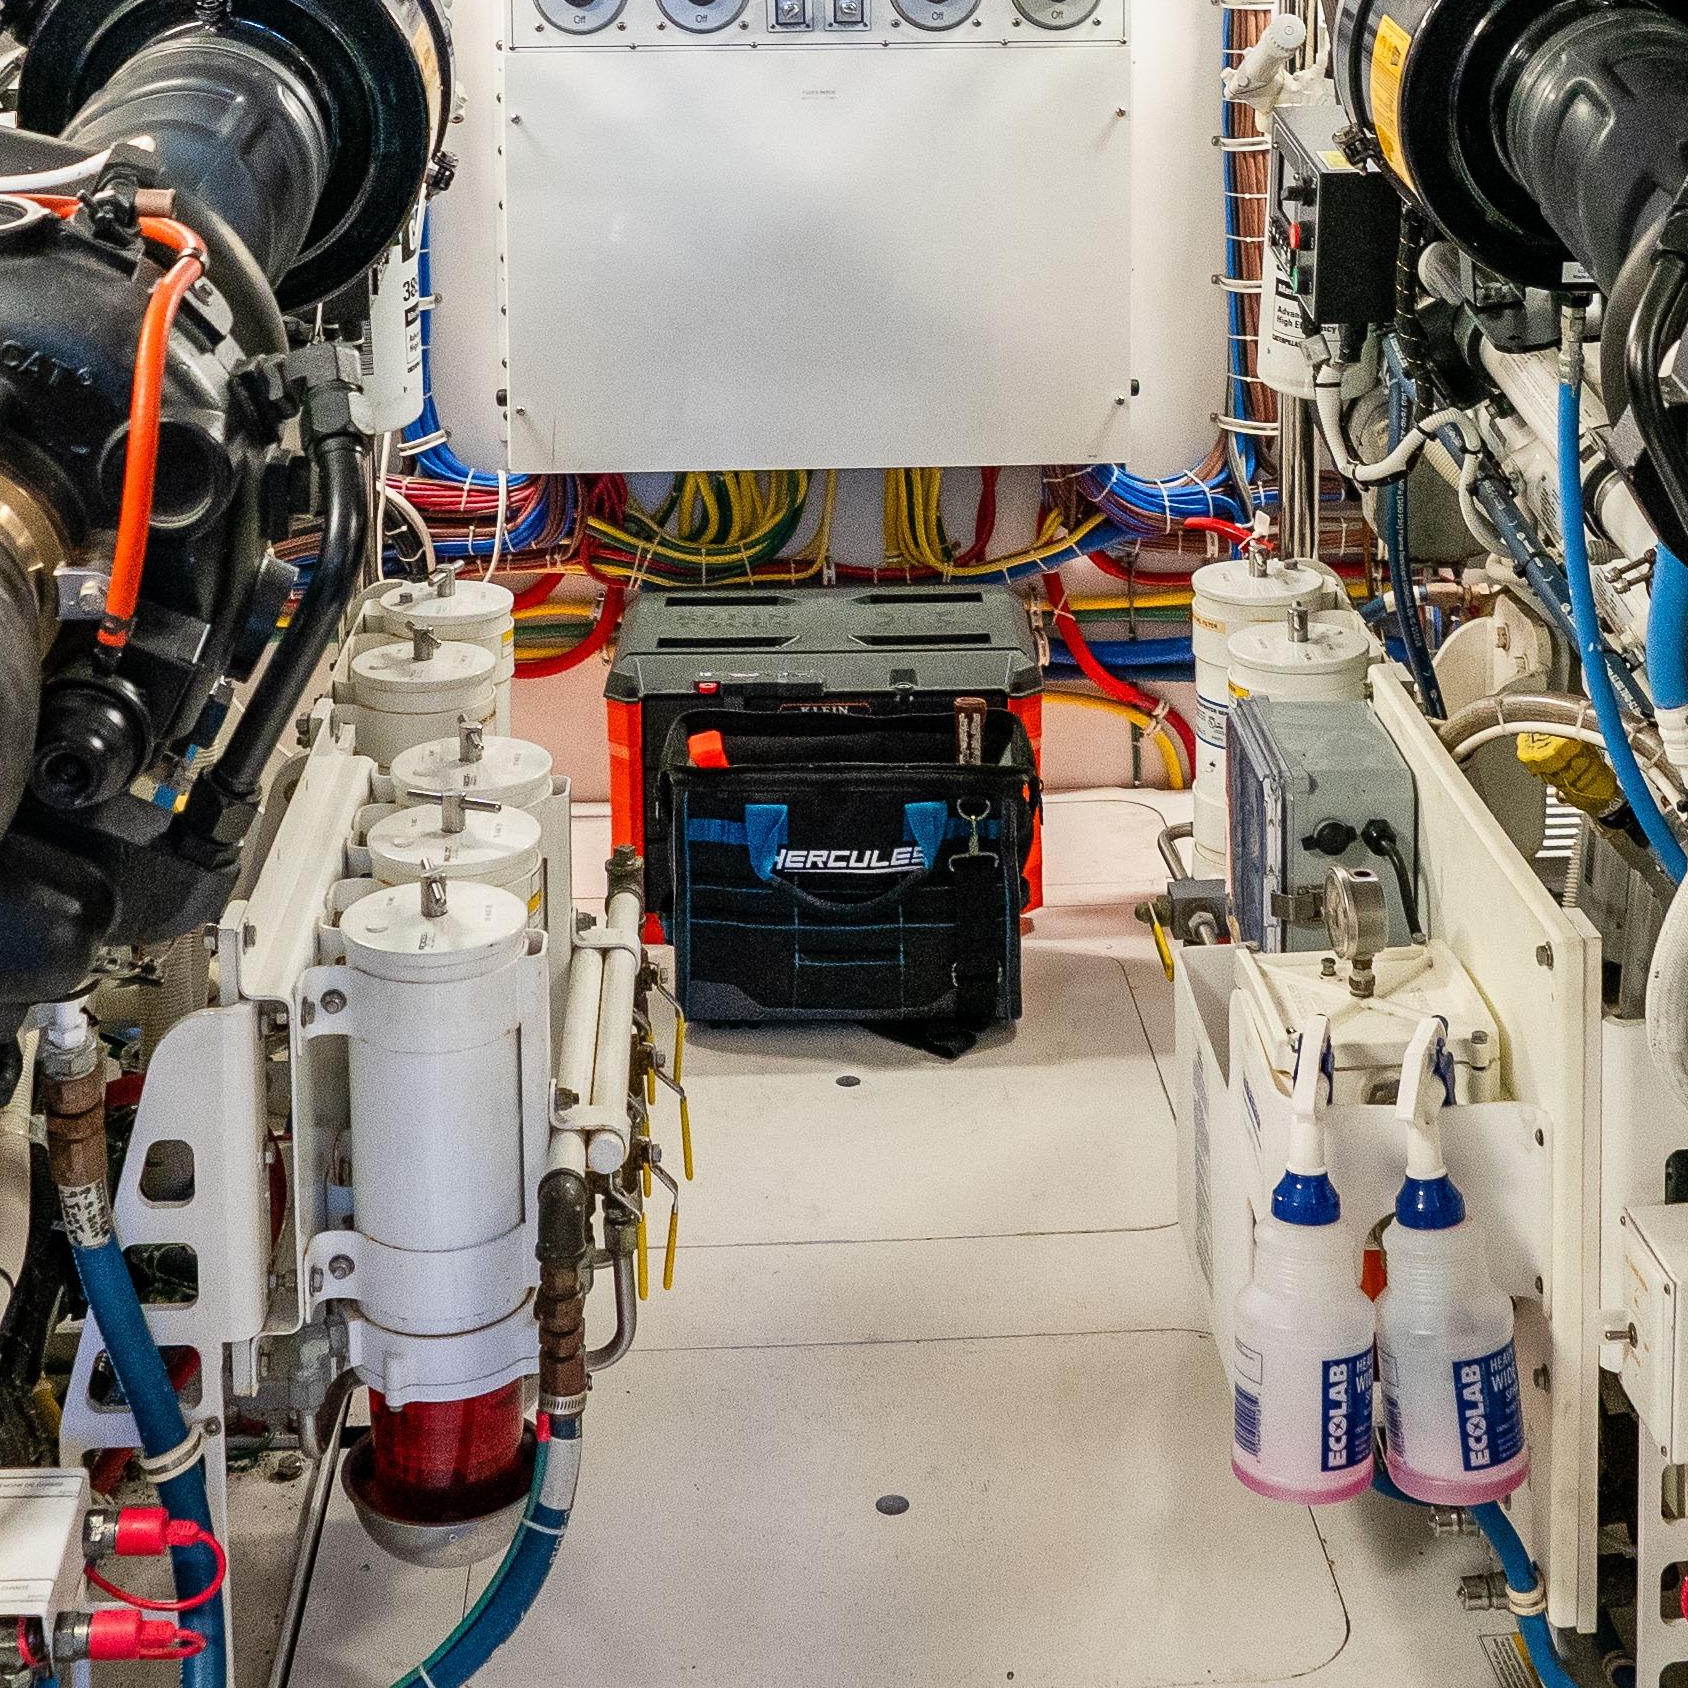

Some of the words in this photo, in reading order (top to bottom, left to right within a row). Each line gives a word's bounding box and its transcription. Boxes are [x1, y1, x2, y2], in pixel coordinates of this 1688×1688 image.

[573, 15, 587, 25] Off
[695, 14, 709, 24] Off
[931, 10, 944, 21] Off
[1051, 9, 1064, 20] Off
[1327, 1363, 1348, 1468] ECOLAB
[1461, 1363, 1491, 1468] ECOLAB
